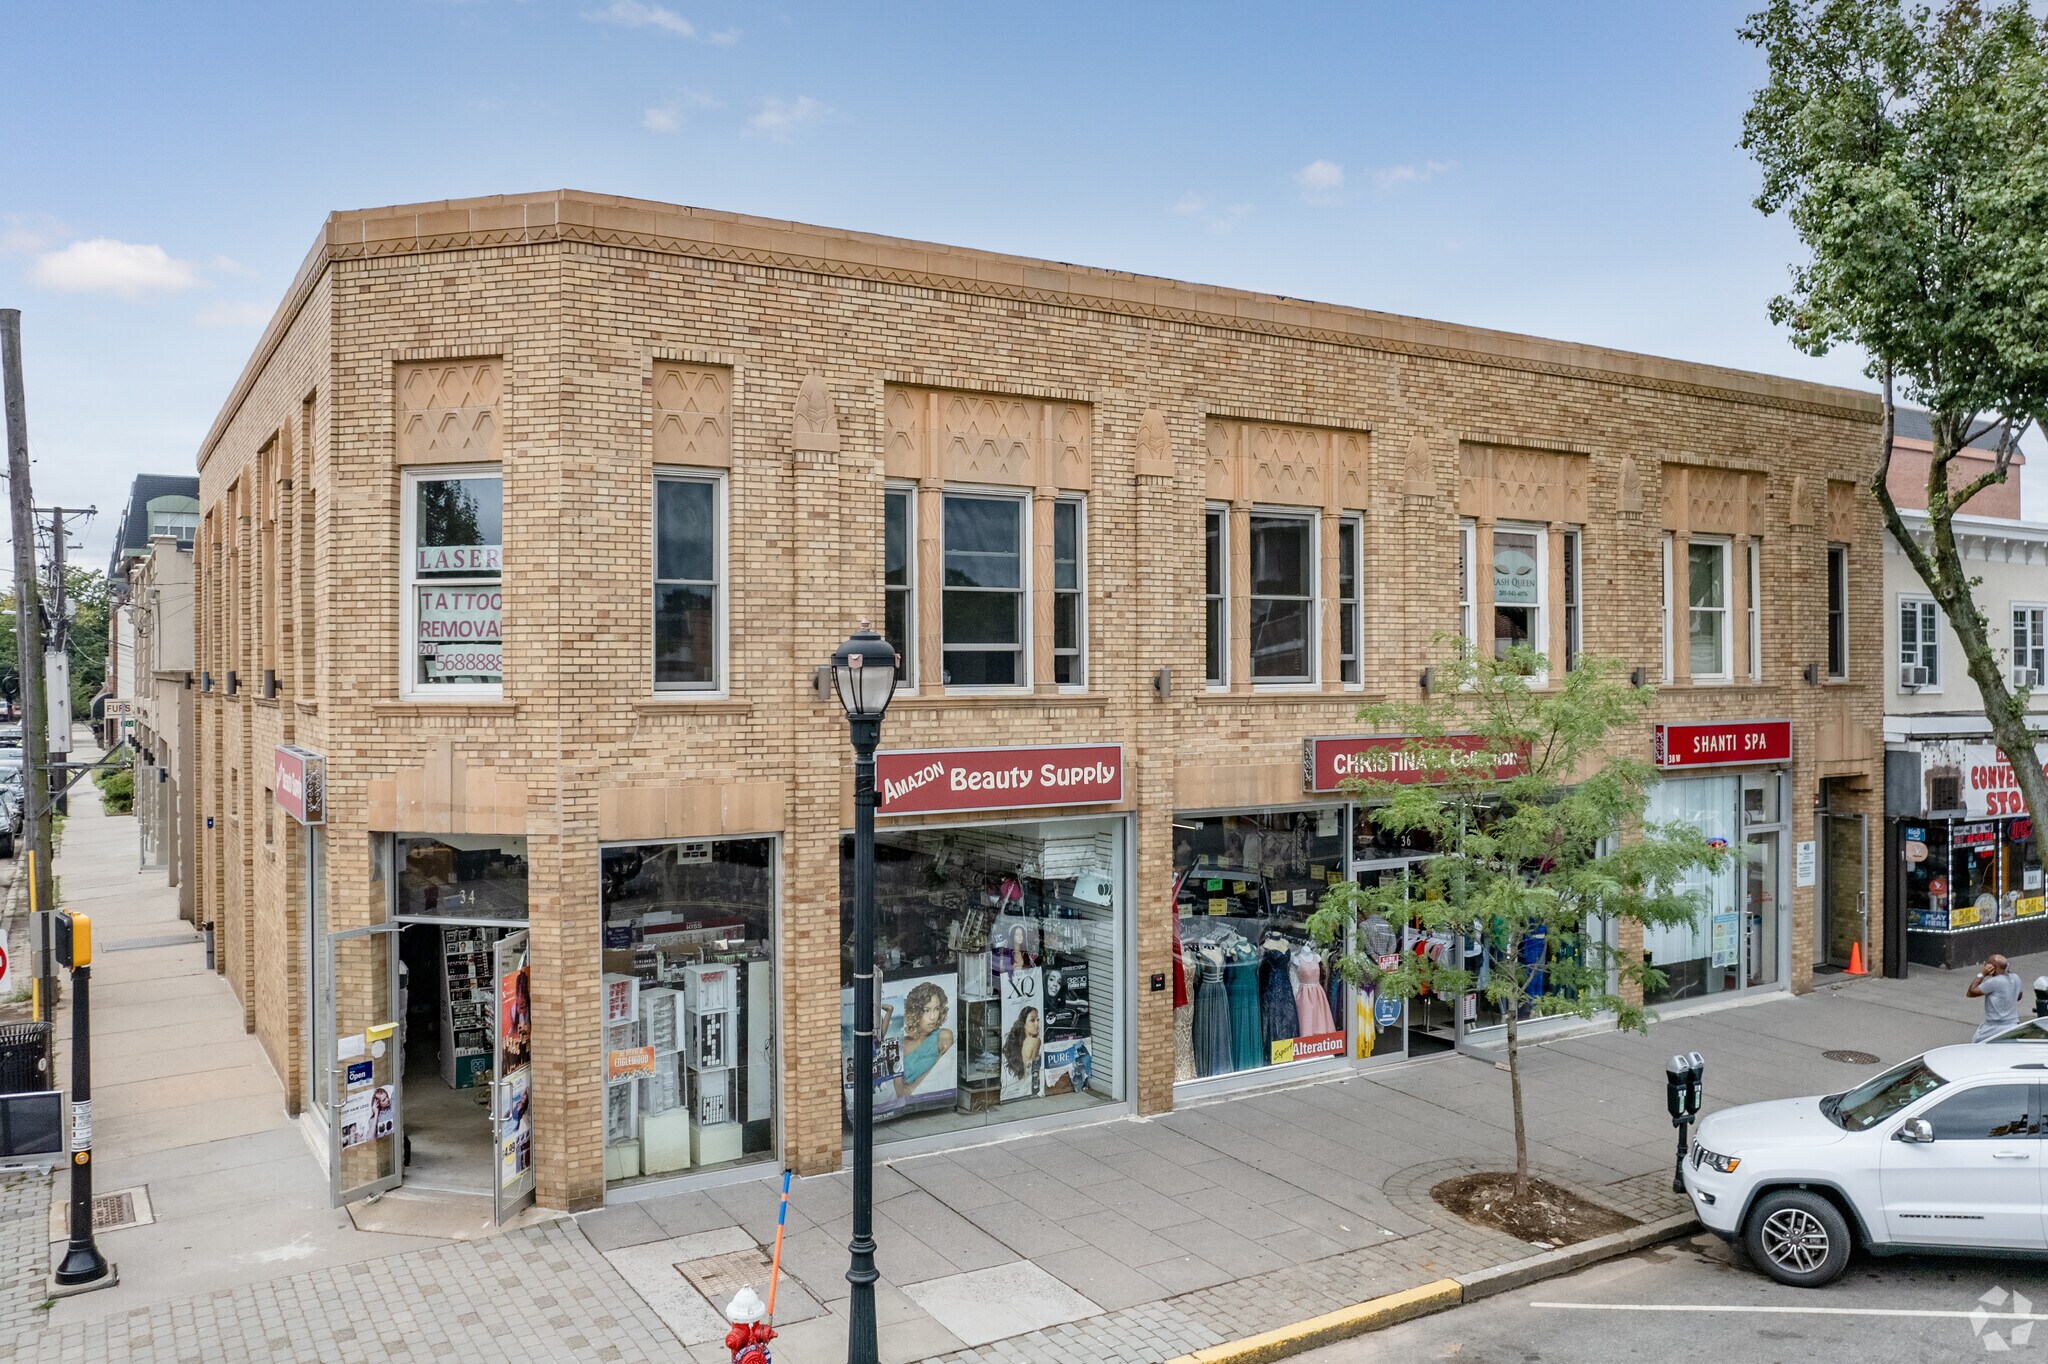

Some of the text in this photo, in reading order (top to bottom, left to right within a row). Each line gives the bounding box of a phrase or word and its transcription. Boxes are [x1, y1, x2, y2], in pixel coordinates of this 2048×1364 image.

[419, 549, 499, 570] LASER
[1512, 577, 1536, 588] QUEEN
[421, 592, 502, 611] TATTOO
[419, 643, 440, 655] 201
[1693, 732, 1767, 753] SHANTI SPA
[884, 761, 1115, 804] AMAZON Beauty Supply
[1401, 835, 1412, 847] 36
[460, 889, 476, 904] 34
[1007, 975, 1036, 1000] XQ
[1293, 1038, 1343, 1056] Alteration
[614, 1054, 649, 1068] ENGLEWOOD
[1048, 1053, 1070, 1064] PURE
[349, 1072, 366, 1081] Open
